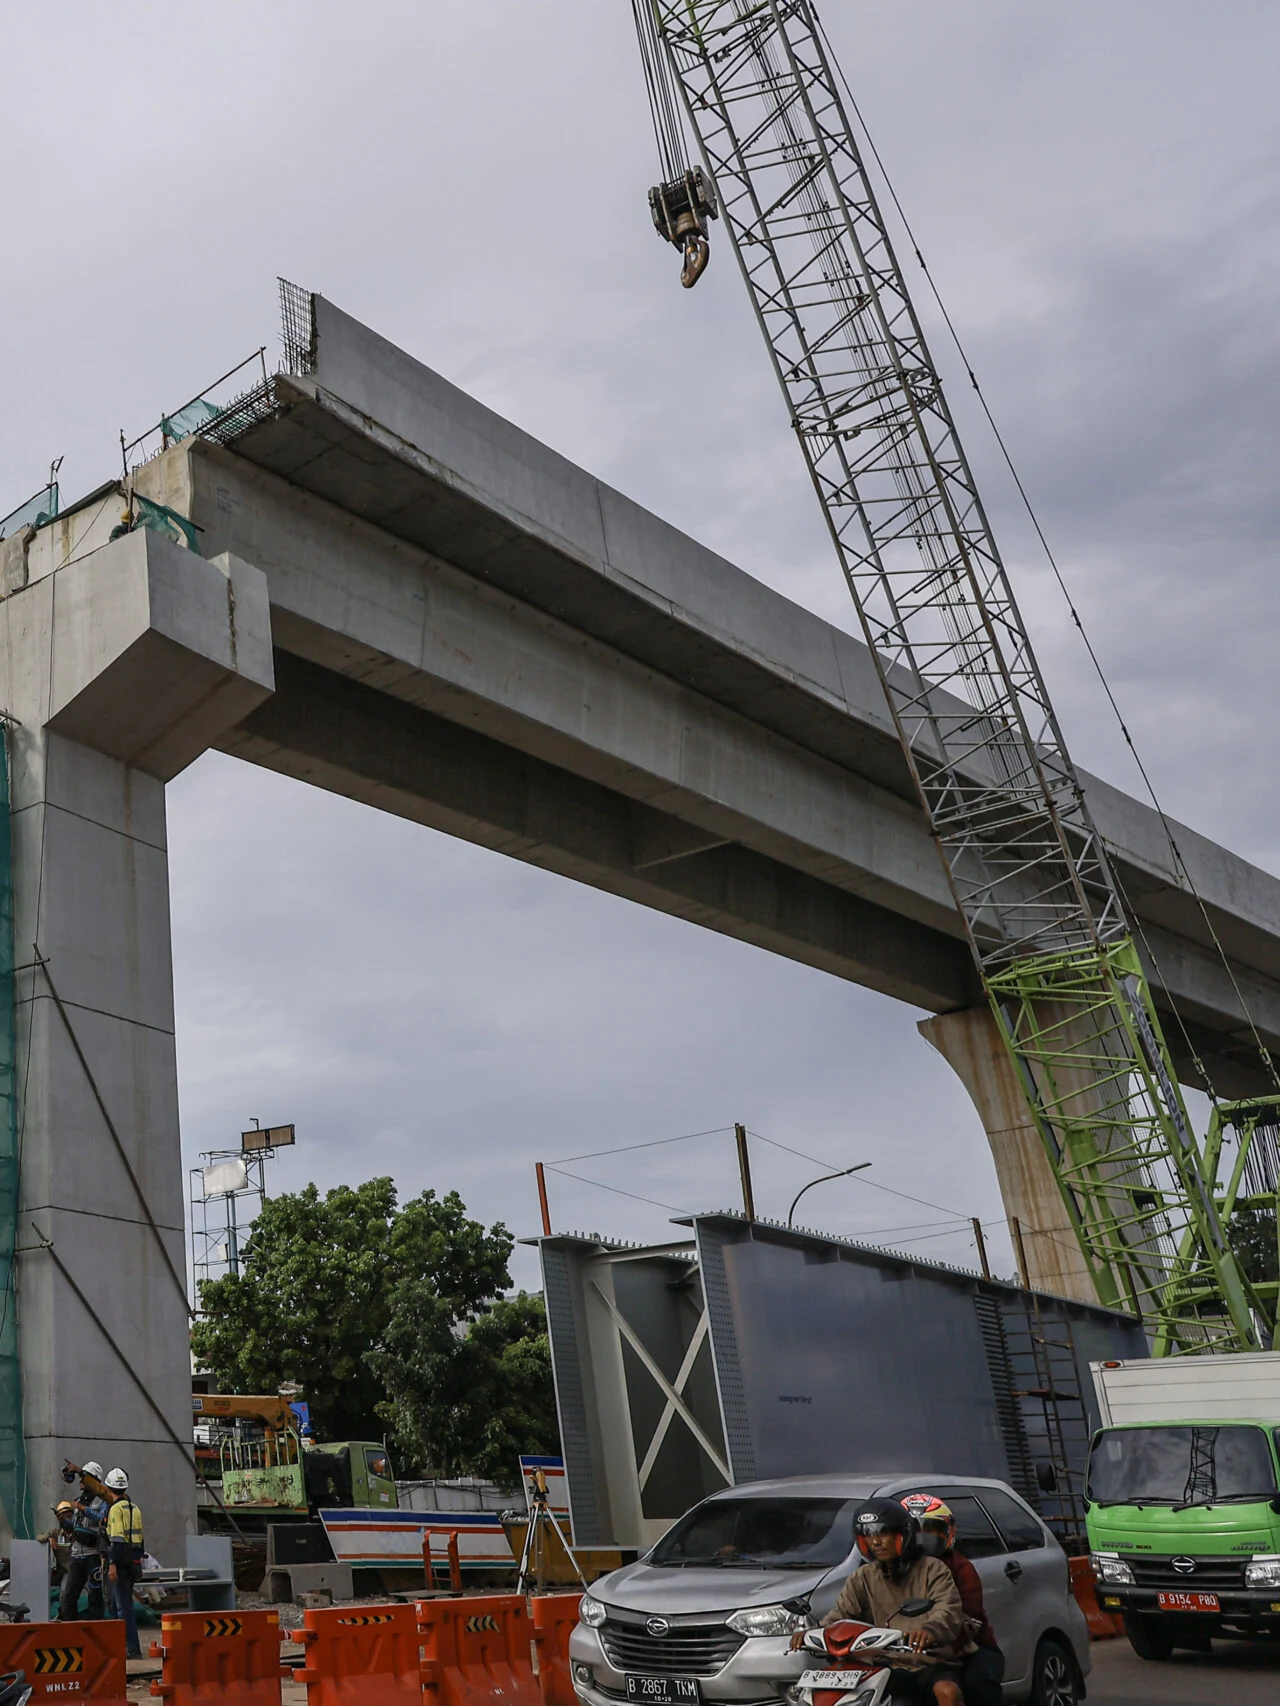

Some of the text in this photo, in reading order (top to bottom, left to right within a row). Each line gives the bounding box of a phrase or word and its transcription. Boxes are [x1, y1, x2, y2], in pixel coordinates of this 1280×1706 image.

[1159, 1593, 1166, 1604] B
[1169, 1593, 1192, 1605] 9154
[45, 1683, 67, 1693] WNL
[628, 1678, 697, 1696] B 2867 TKM
